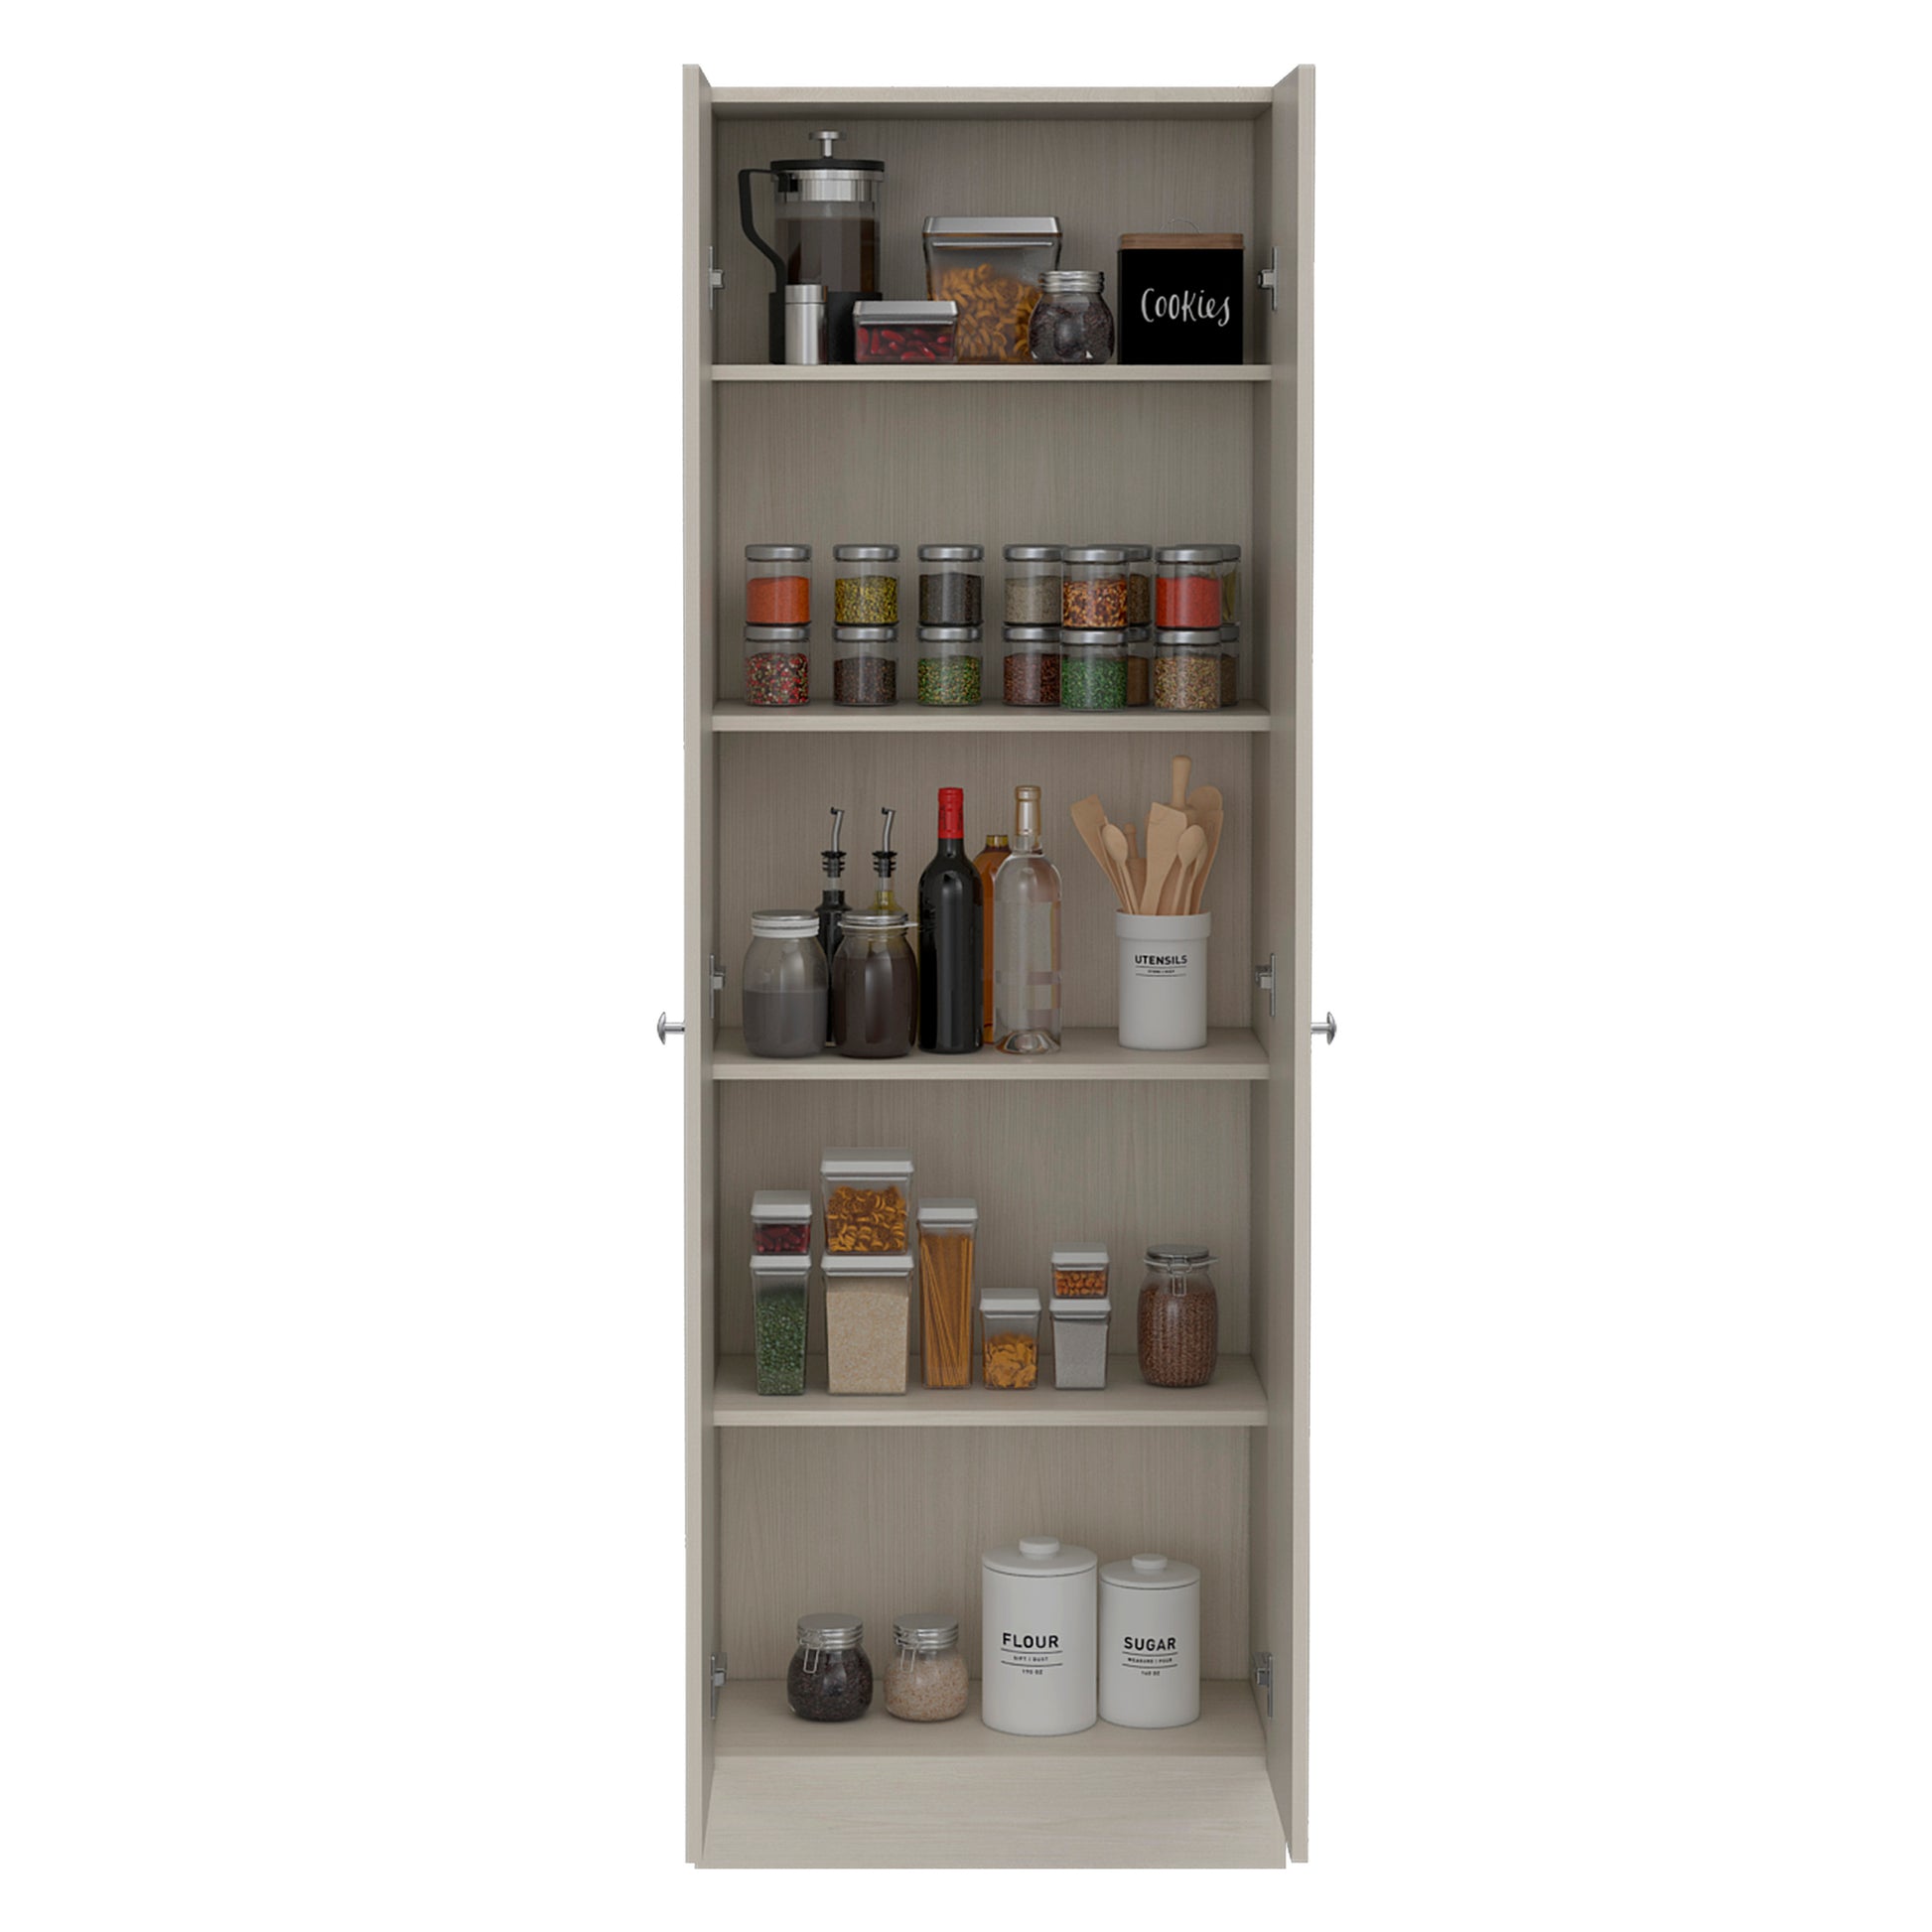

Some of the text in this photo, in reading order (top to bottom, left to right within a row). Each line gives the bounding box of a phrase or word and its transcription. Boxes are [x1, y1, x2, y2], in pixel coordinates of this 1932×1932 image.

[1141, 287, 1230, 327] Cookies
[1135, 954, 1187, 965] UTENSILS
[1003, 1632, 1058, 1648] FLOUR
[1124, 1636, 1176, 1651] SUGAR
